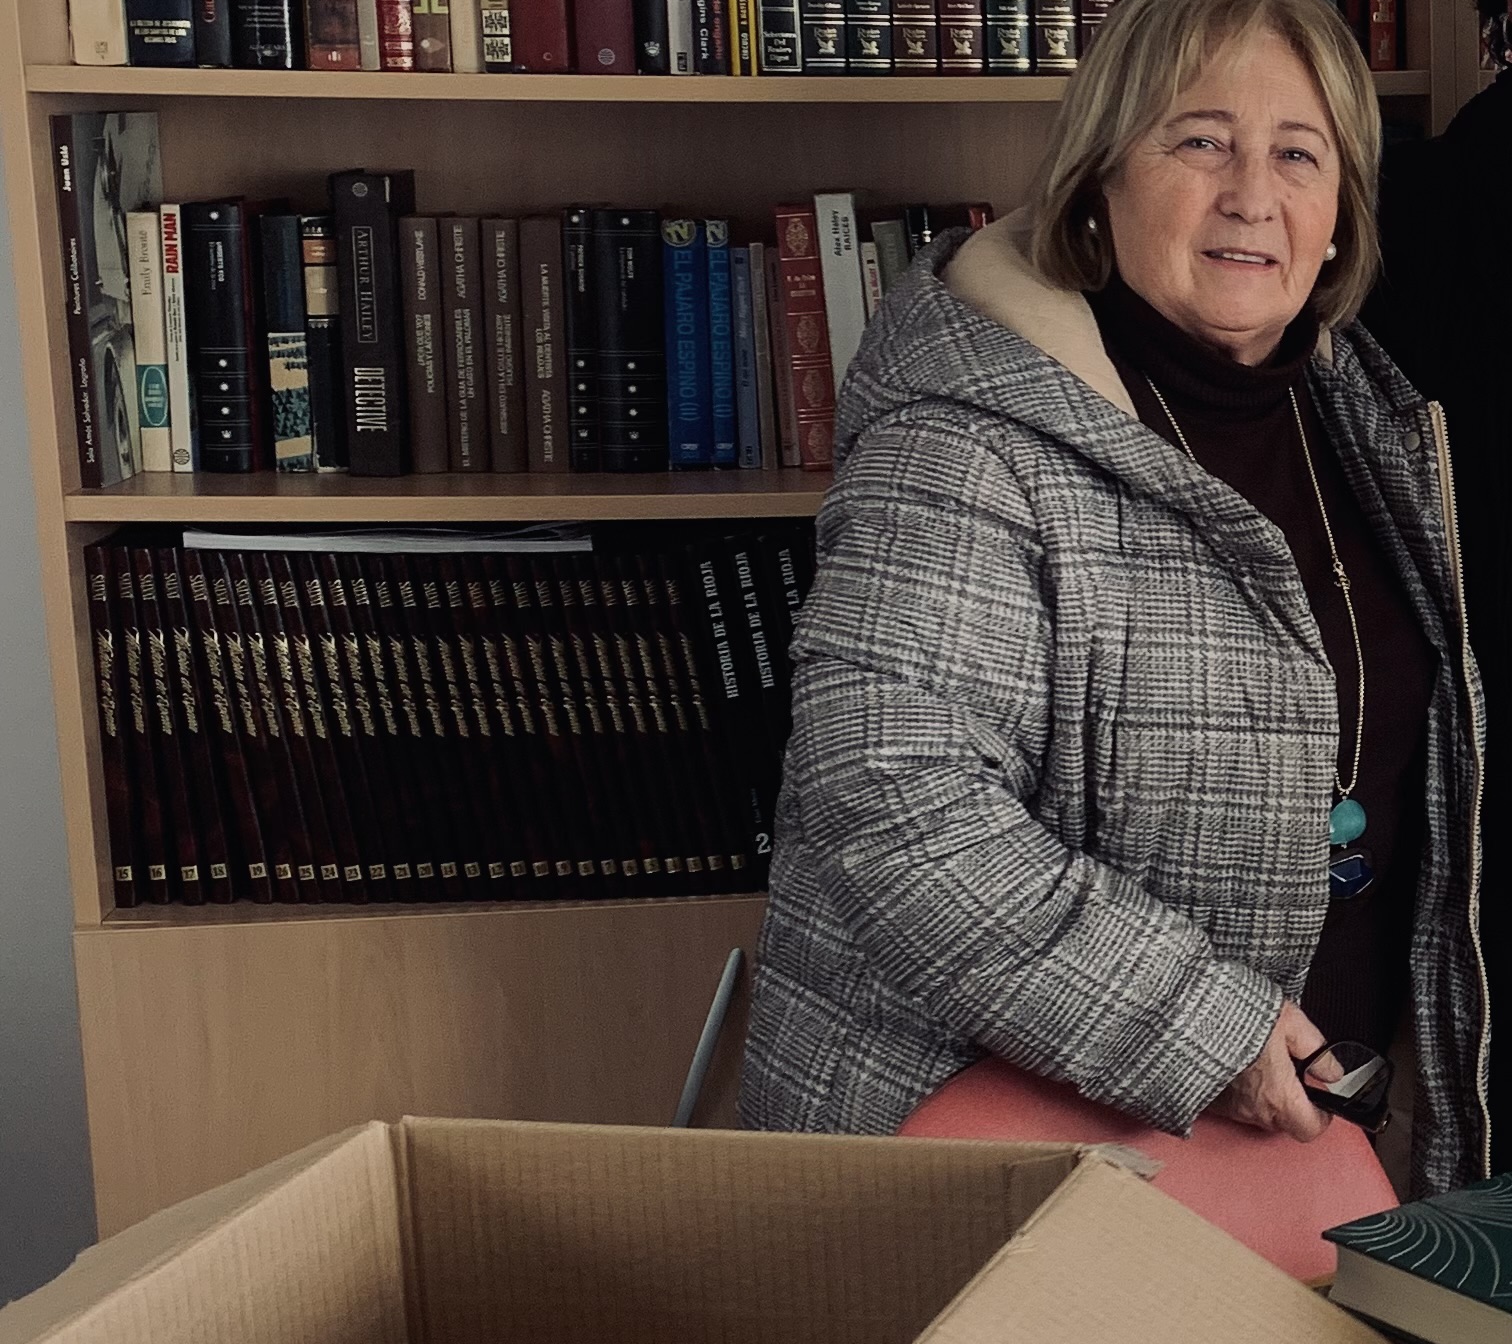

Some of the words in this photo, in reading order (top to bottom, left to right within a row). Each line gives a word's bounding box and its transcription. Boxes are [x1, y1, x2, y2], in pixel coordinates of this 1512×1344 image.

[699, 28, 709, 60] Clark
[62, 167, 73, 192] Juan
[163, 212, 178, 241] MAN
[164, 243, 179, 274] RAIN
[357, 230, 371, 284] ARTHUR
[453, 225, 464, 263] CHRISTIE
[496, 230, 506, 268] CHRISTIE
[674, 249, 693, 270] EL
[709, 249, 726, 270] EL
[141, 267, 152, 296] Emily
[457, 264, 466, 299] AGATHA
[540, 263, 548, 274] LA
[498, 269, 507, 303] AGATHA
[359, 291, 373, 341] HAILEY
[677, 339, 698, 399] ESPINO
[712, 340, 731, 399] ESPINO
[82, 392, 91, 423] Salvador
[354, 367, 388, 432] DETECTIVE
[459, 399, 467, 409] LA
[542, 389, 551, 425] AGATHA
[678, 401, 701, 422] (II)
[713, 403, 734, 418] (I)
[87, 447, 95, 463] Sala
[543, 425, 553, 463] CHRISTIE
[700, 560, 718, 597] RIOJA
[735, 551, 753, 588] RIOJA
[778, 548, 796, 586] RIOJA
[708, 600, 723, 618] LA
[743, 591, 758, 609] LA
[786, 589, 799, 606] LA
[713, 620, 727, 638] DE
[747, 611, 762, 628] DE
[789, 609, 802, 625] DE
[717, 640, 740, 699] HISTORIA
[751, 630, 774, 689] HISTORIA
[755, 832, 772, 855] 2
